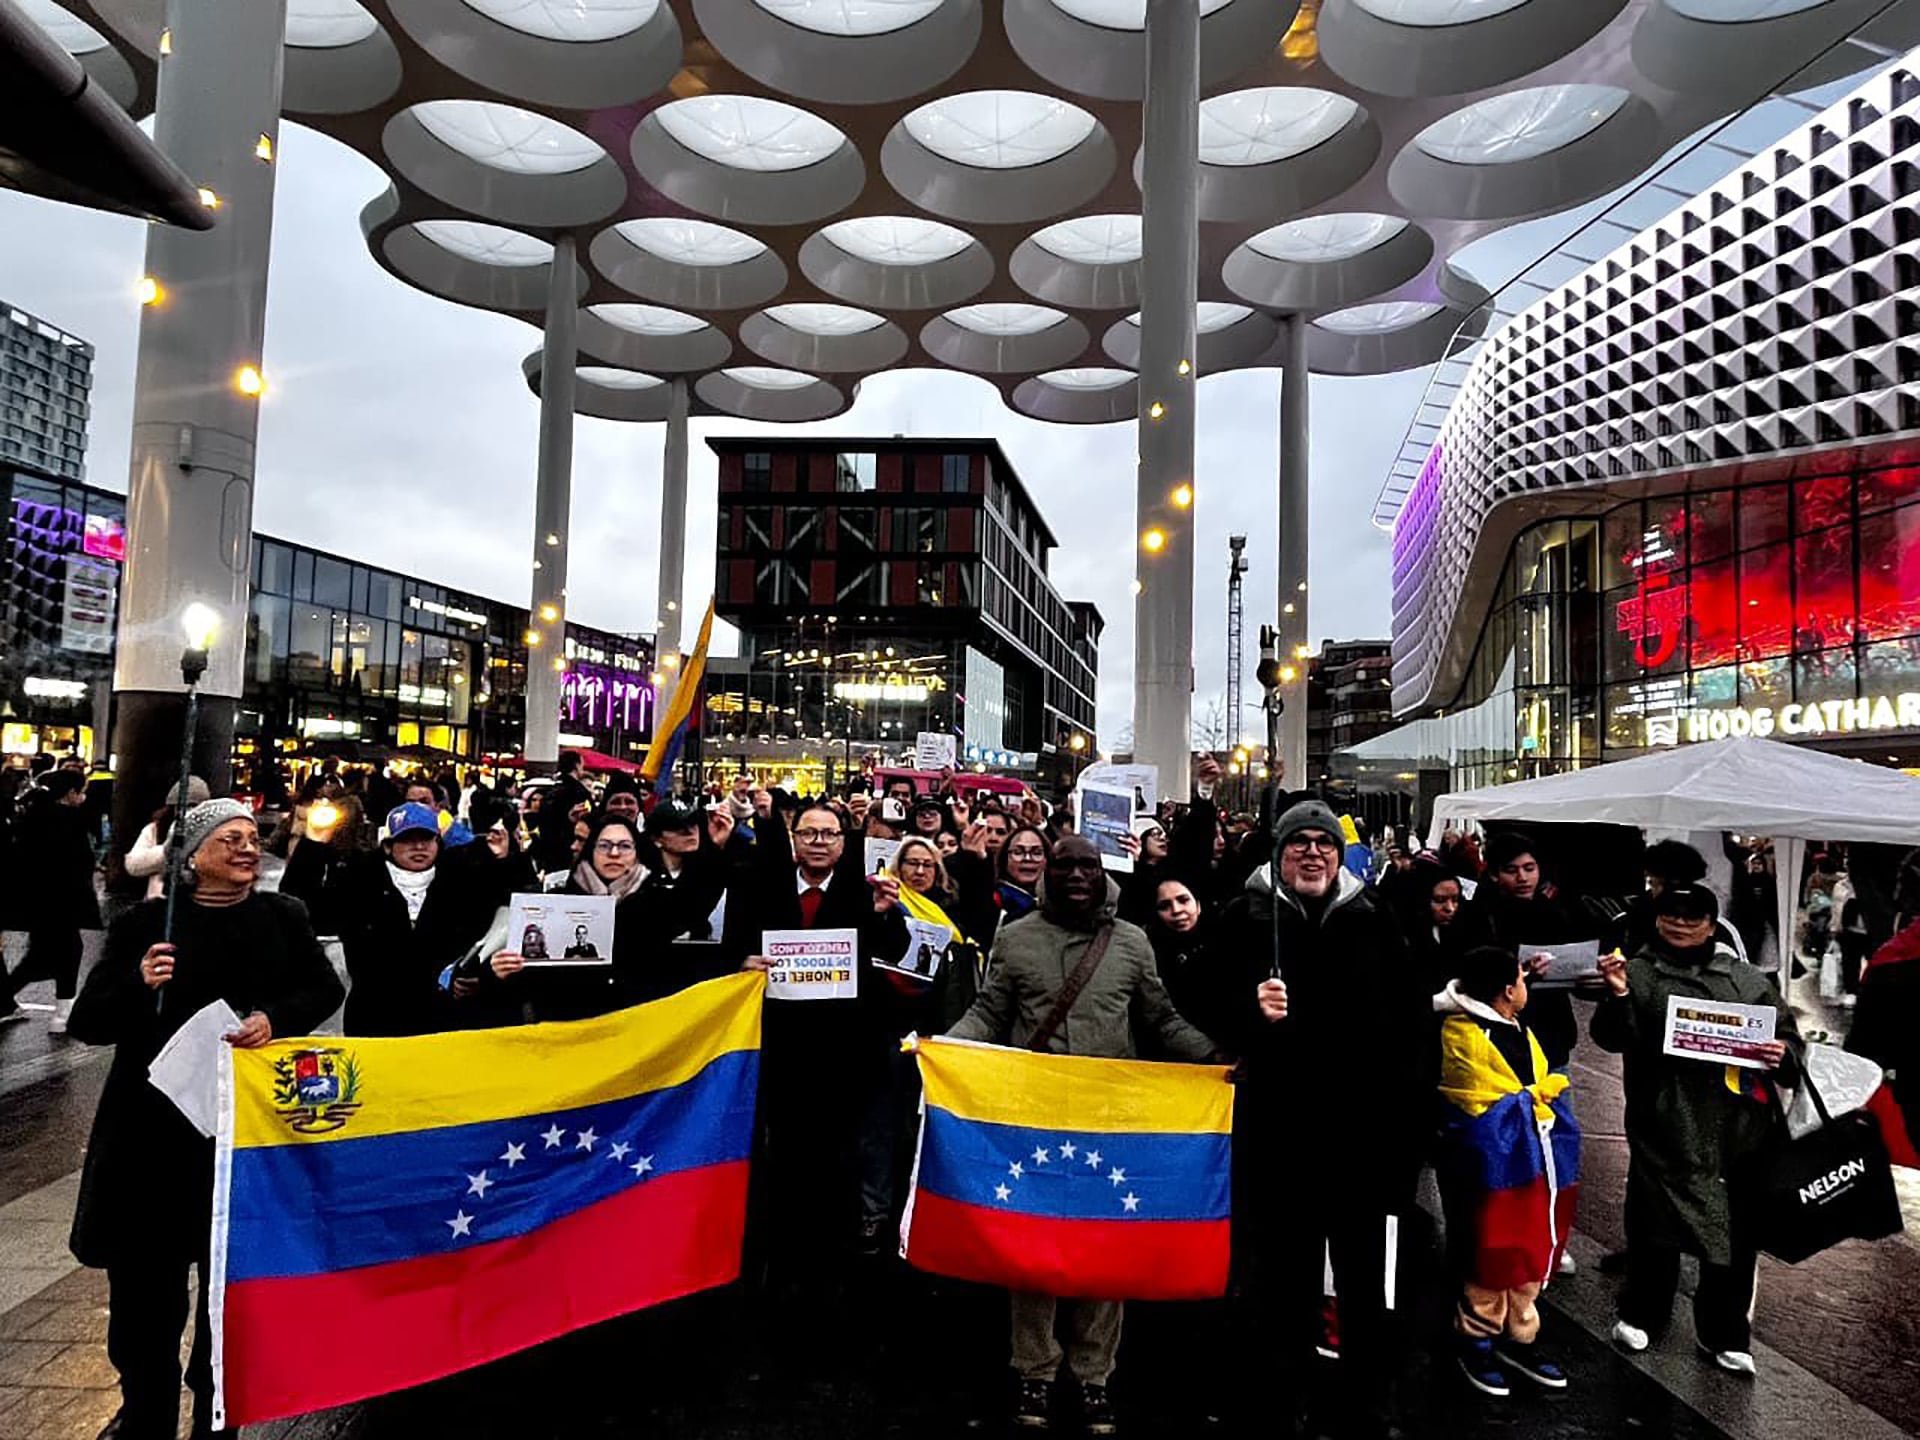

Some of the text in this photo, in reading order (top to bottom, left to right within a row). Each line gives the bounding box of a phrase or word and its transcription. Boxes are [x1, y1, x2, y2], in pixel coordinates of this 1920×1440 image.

[1688, 706, 1775, 741] HOOG
[771, 958, 791, 968] LO
[794, 957, 832, 968] TODOS
[770, 970, 850, 983] EL NOBEL ES
[1697, 1012, 1744, 1027] NOBEL
[1748, 1018, 1763, 1028] ES
[1798, 1157, 1865, 1204] NELSON
